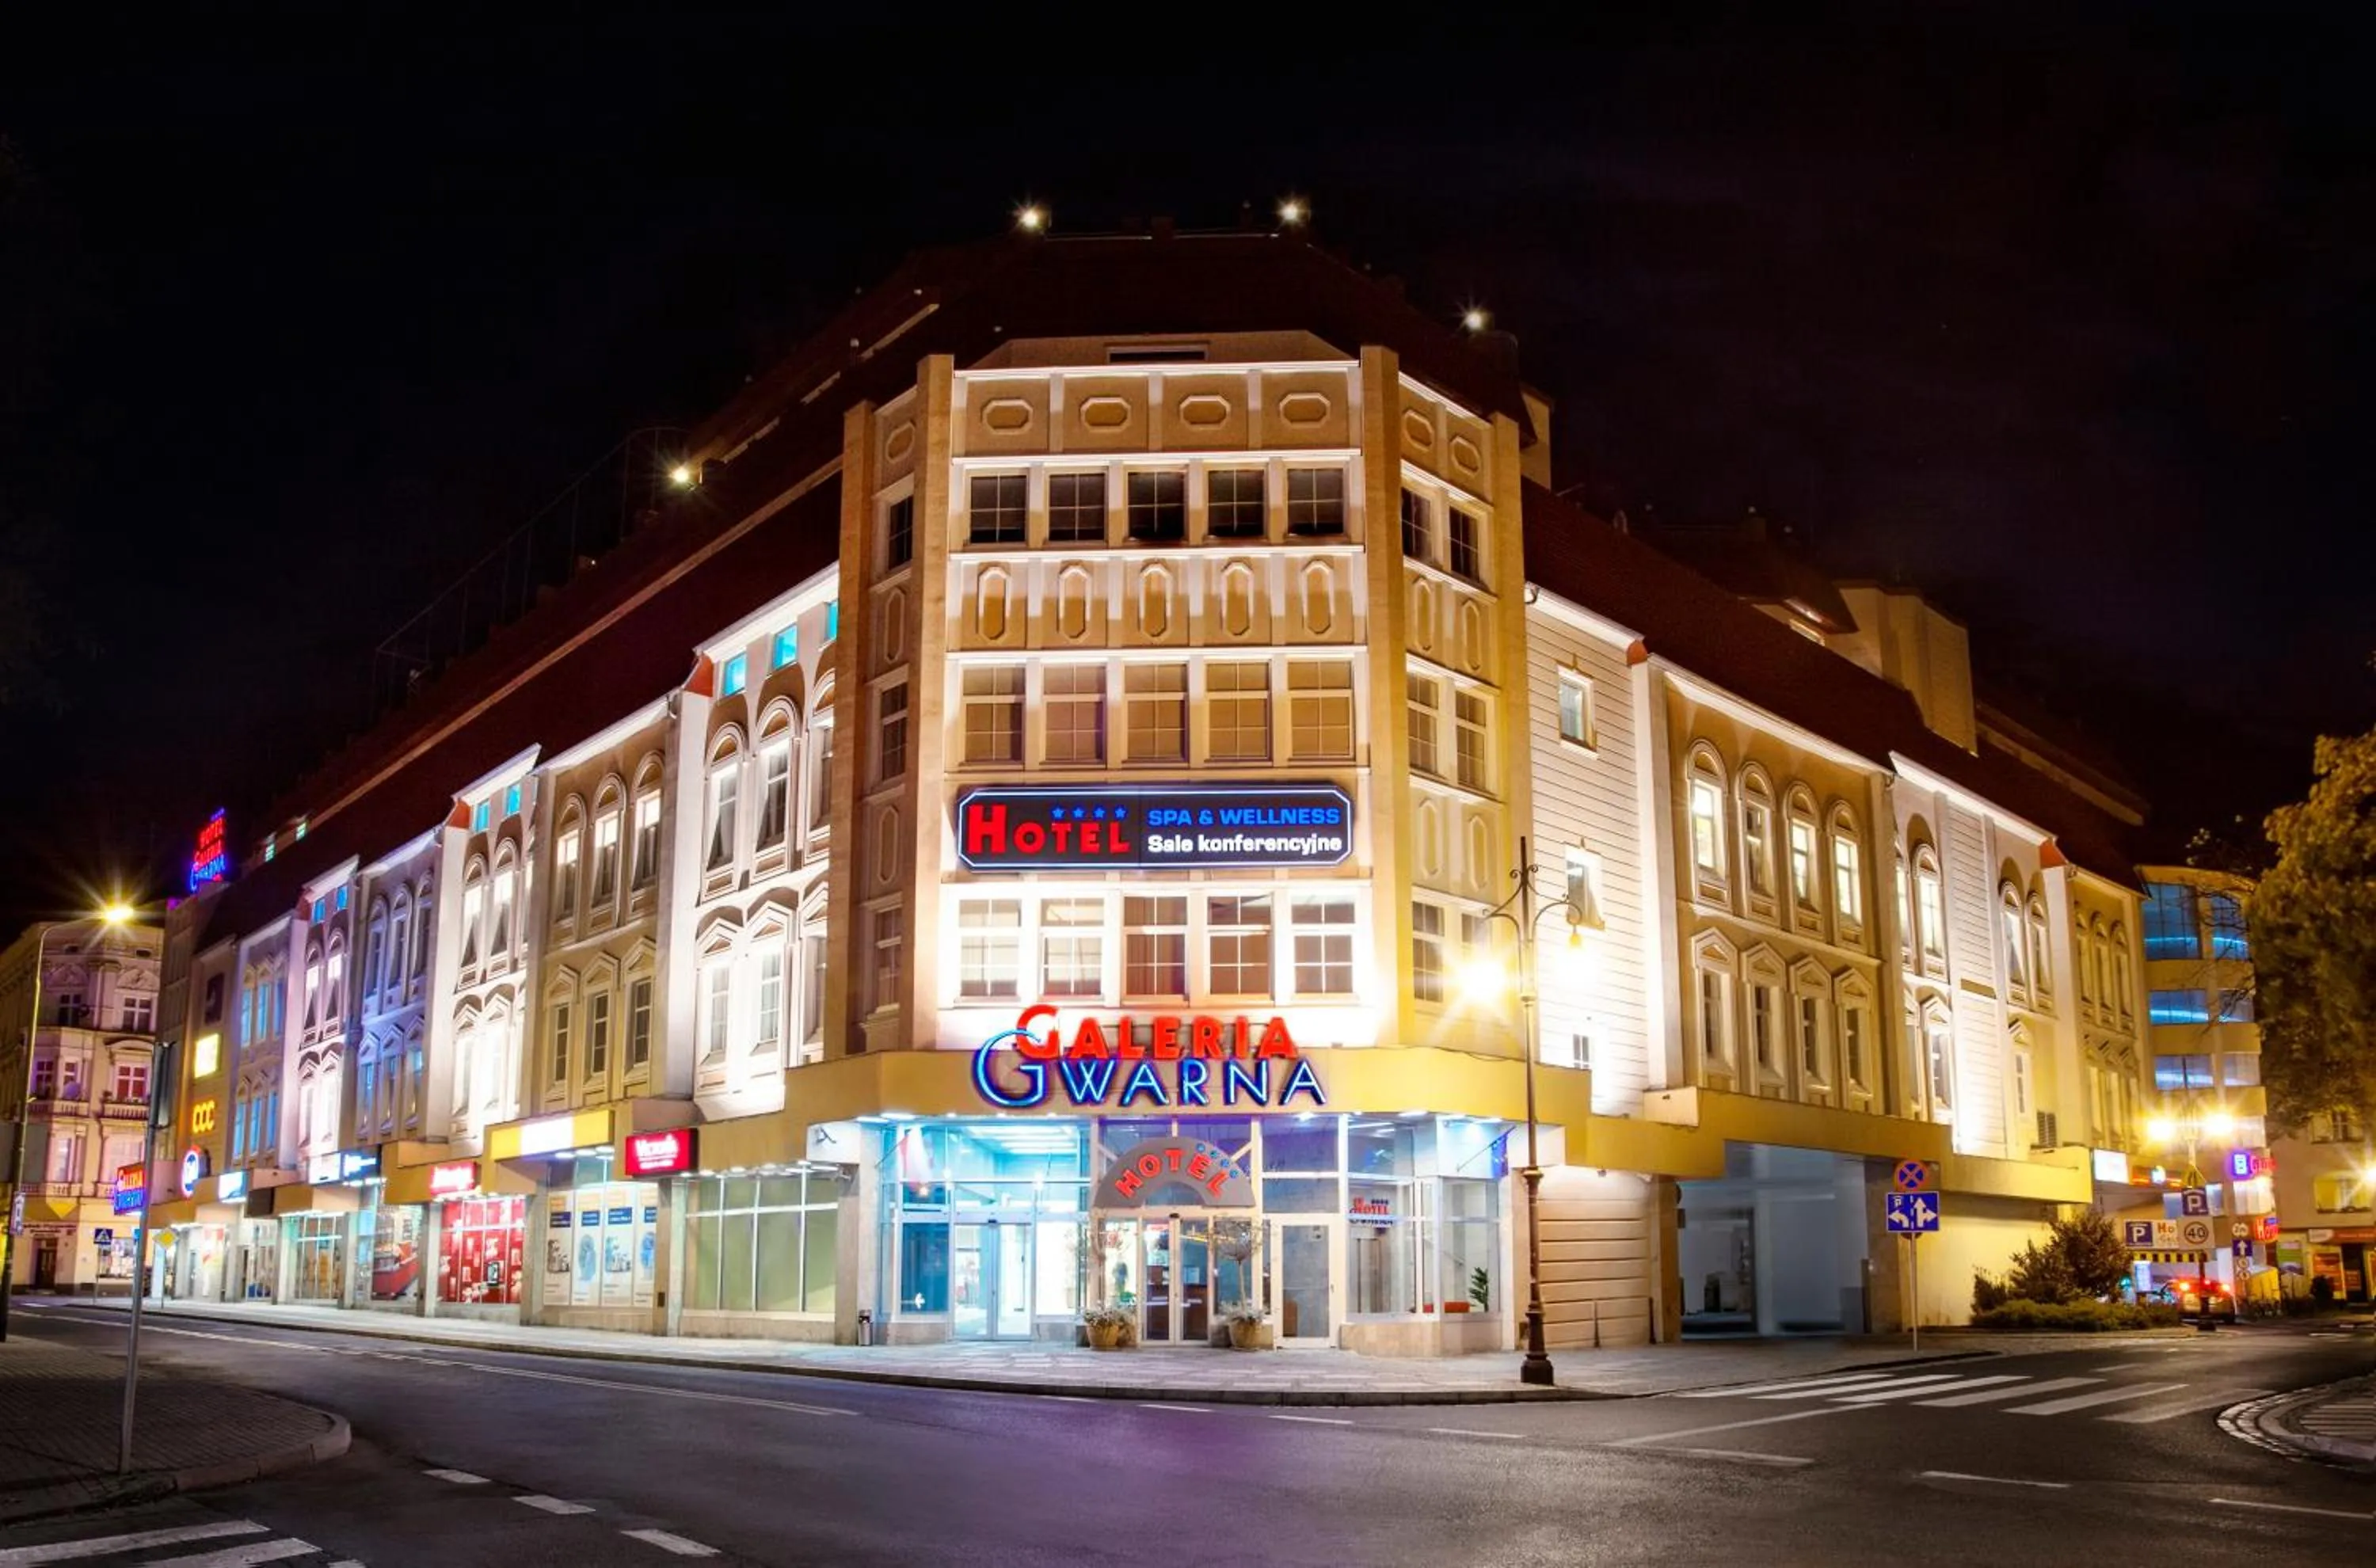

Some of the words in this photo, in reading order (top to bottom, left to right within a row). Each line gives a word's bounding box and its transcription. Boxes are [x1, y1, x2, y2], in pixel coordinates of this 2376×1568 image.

[968, 804, 1131, 854] HOTEL
[1148, 809, 1192, 826] SPA
[1198, 809, 1214, 826] &
[1219, 807, 1342, 826] WELLNESS
[1148, 834, 1194, 854] Sale
[1198, 832, 1342, 855] konferencyjne
[1016, 1003, 1299, 1060] GALERIA
[973, 1029, 1327, 1106] GWARNA
[192, 1099, 215, 1134] CCC
[1115, 1148, 1228, 1198] HOTEL
[2187, 1194, 2201, 1212] P
[2132, 1226, 2146, 1243] P
[2188, 1227, 2206, 1238] 40
